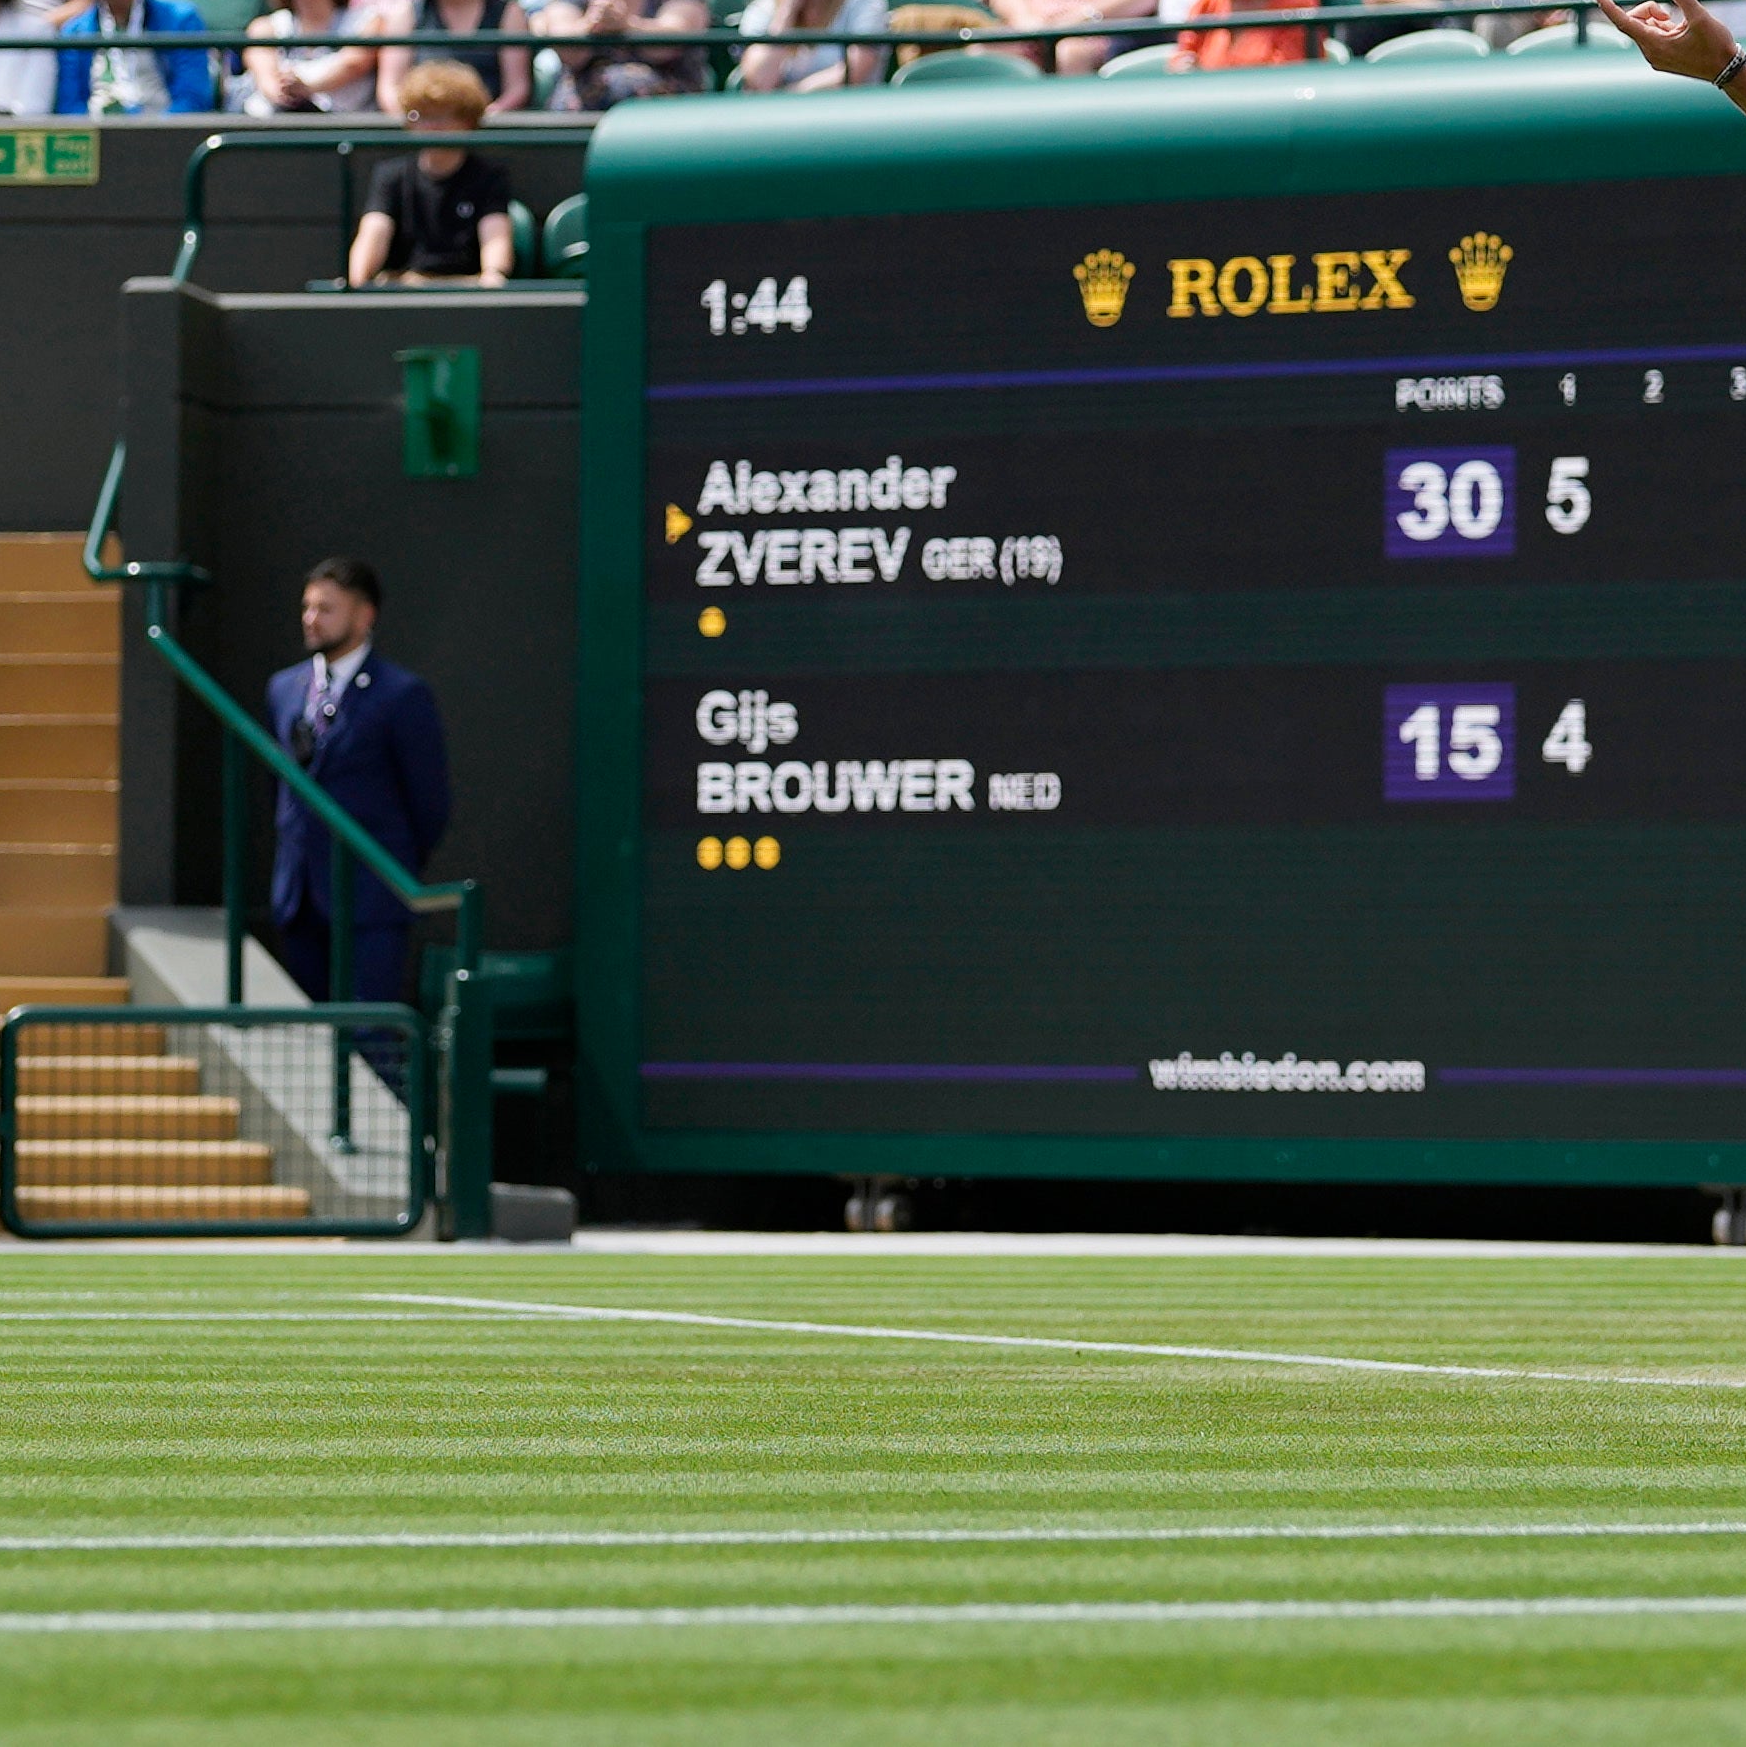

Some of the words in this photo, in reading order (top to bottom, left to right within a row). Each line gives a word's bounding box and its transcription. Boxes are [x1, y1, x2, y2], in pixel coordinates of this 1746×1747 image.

[701, 277, 812, 335] 1:44
[1167, 249, 1414, 317] ROLEX
[1396, 375, 1505, 412] POINTS
[1559, 373, 1576, 406] 1
[1644, 370, 1663, 403] 2
[697, 455, 957, 515] Alexander
[1398, 461, 1502, 539] 30
[1545, 457, 1591, 534] 5
[696, 526, 911, 586] ZVEREV
[922, 537, 997, 580] GER
[999, 535, 1063, 585] (19)
[696, 690, 798, 754] Gijs
[1400, 705, 1502, 779] 15
[1543, 699, 1592, 773] 4
[697, 759, 974, 813] BROUWER
[989, 773, 1061, 810] NED
[1149, 1052, 1425, 1092] wimbledon.com
